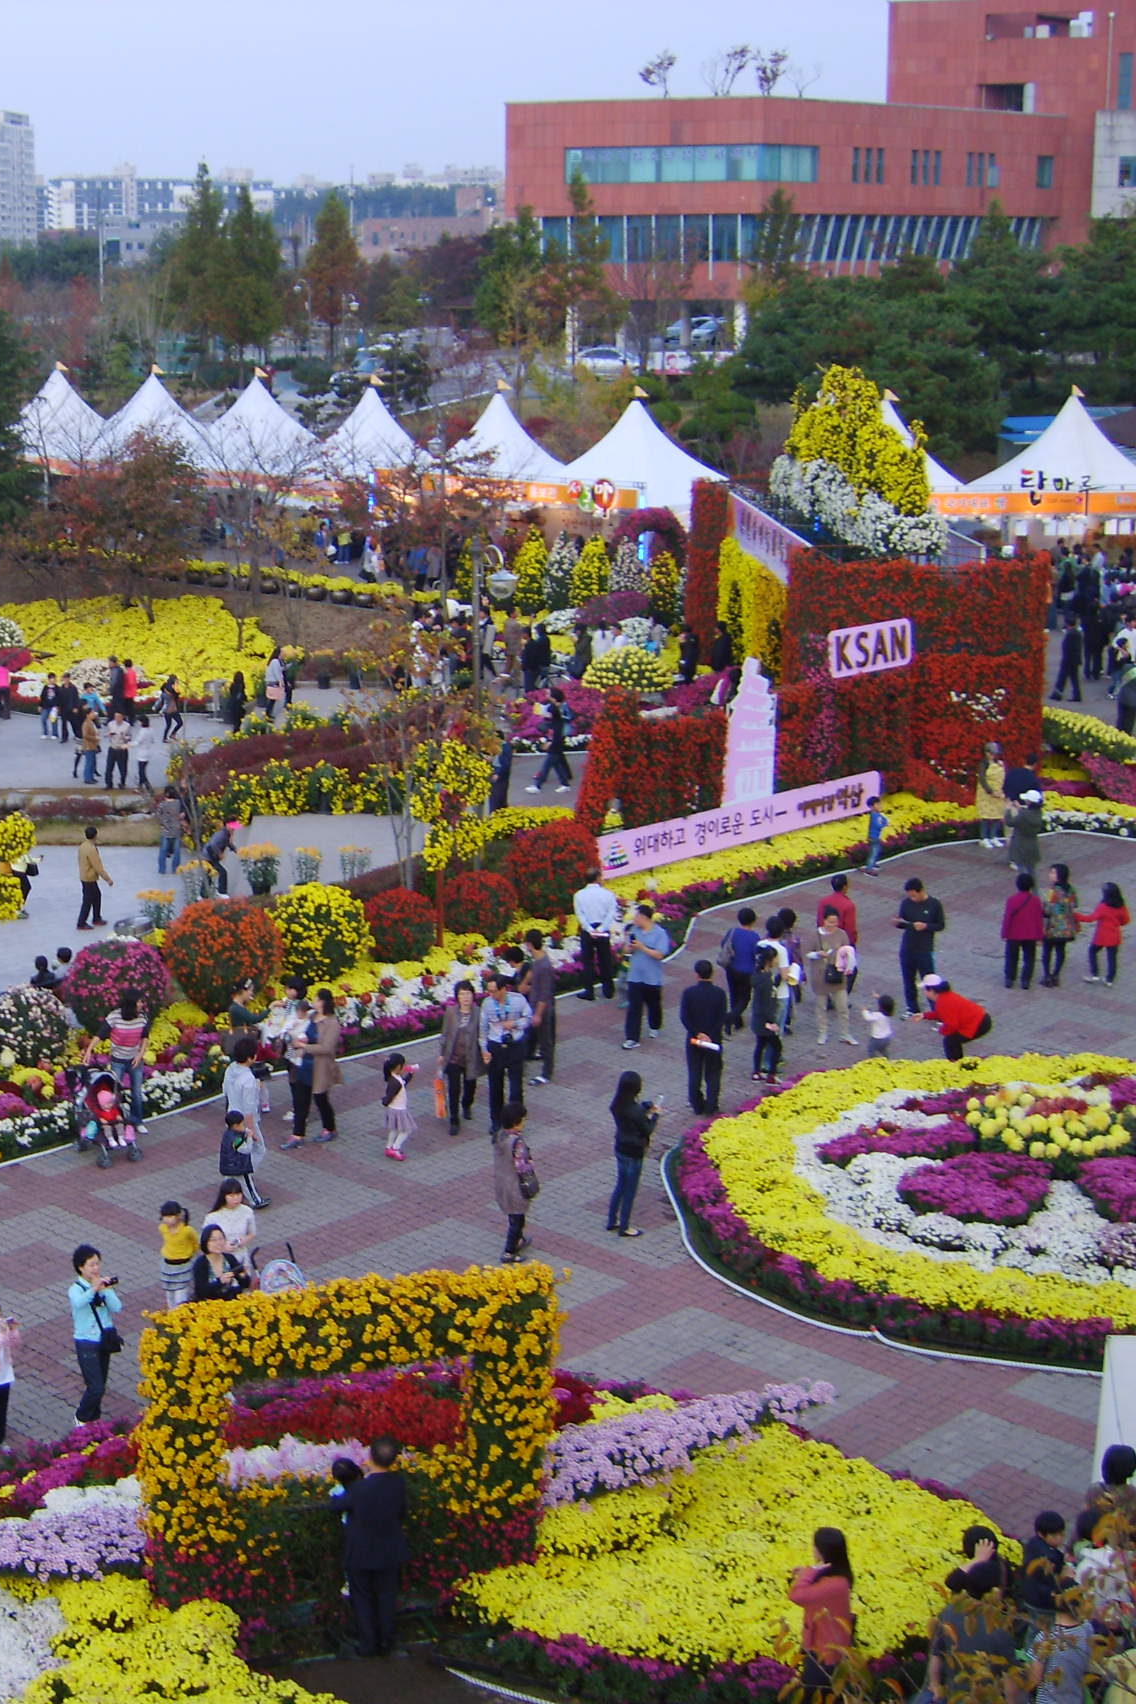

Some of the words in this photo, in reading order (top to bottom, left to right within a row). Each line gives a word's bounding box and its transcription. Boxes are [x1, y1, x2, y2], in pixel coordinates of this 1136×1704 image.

[834, 624, 907, 672] KSAN
[633, 827, 686, 857] 위대하고
[695, 811, 744, 847] 경이로운
